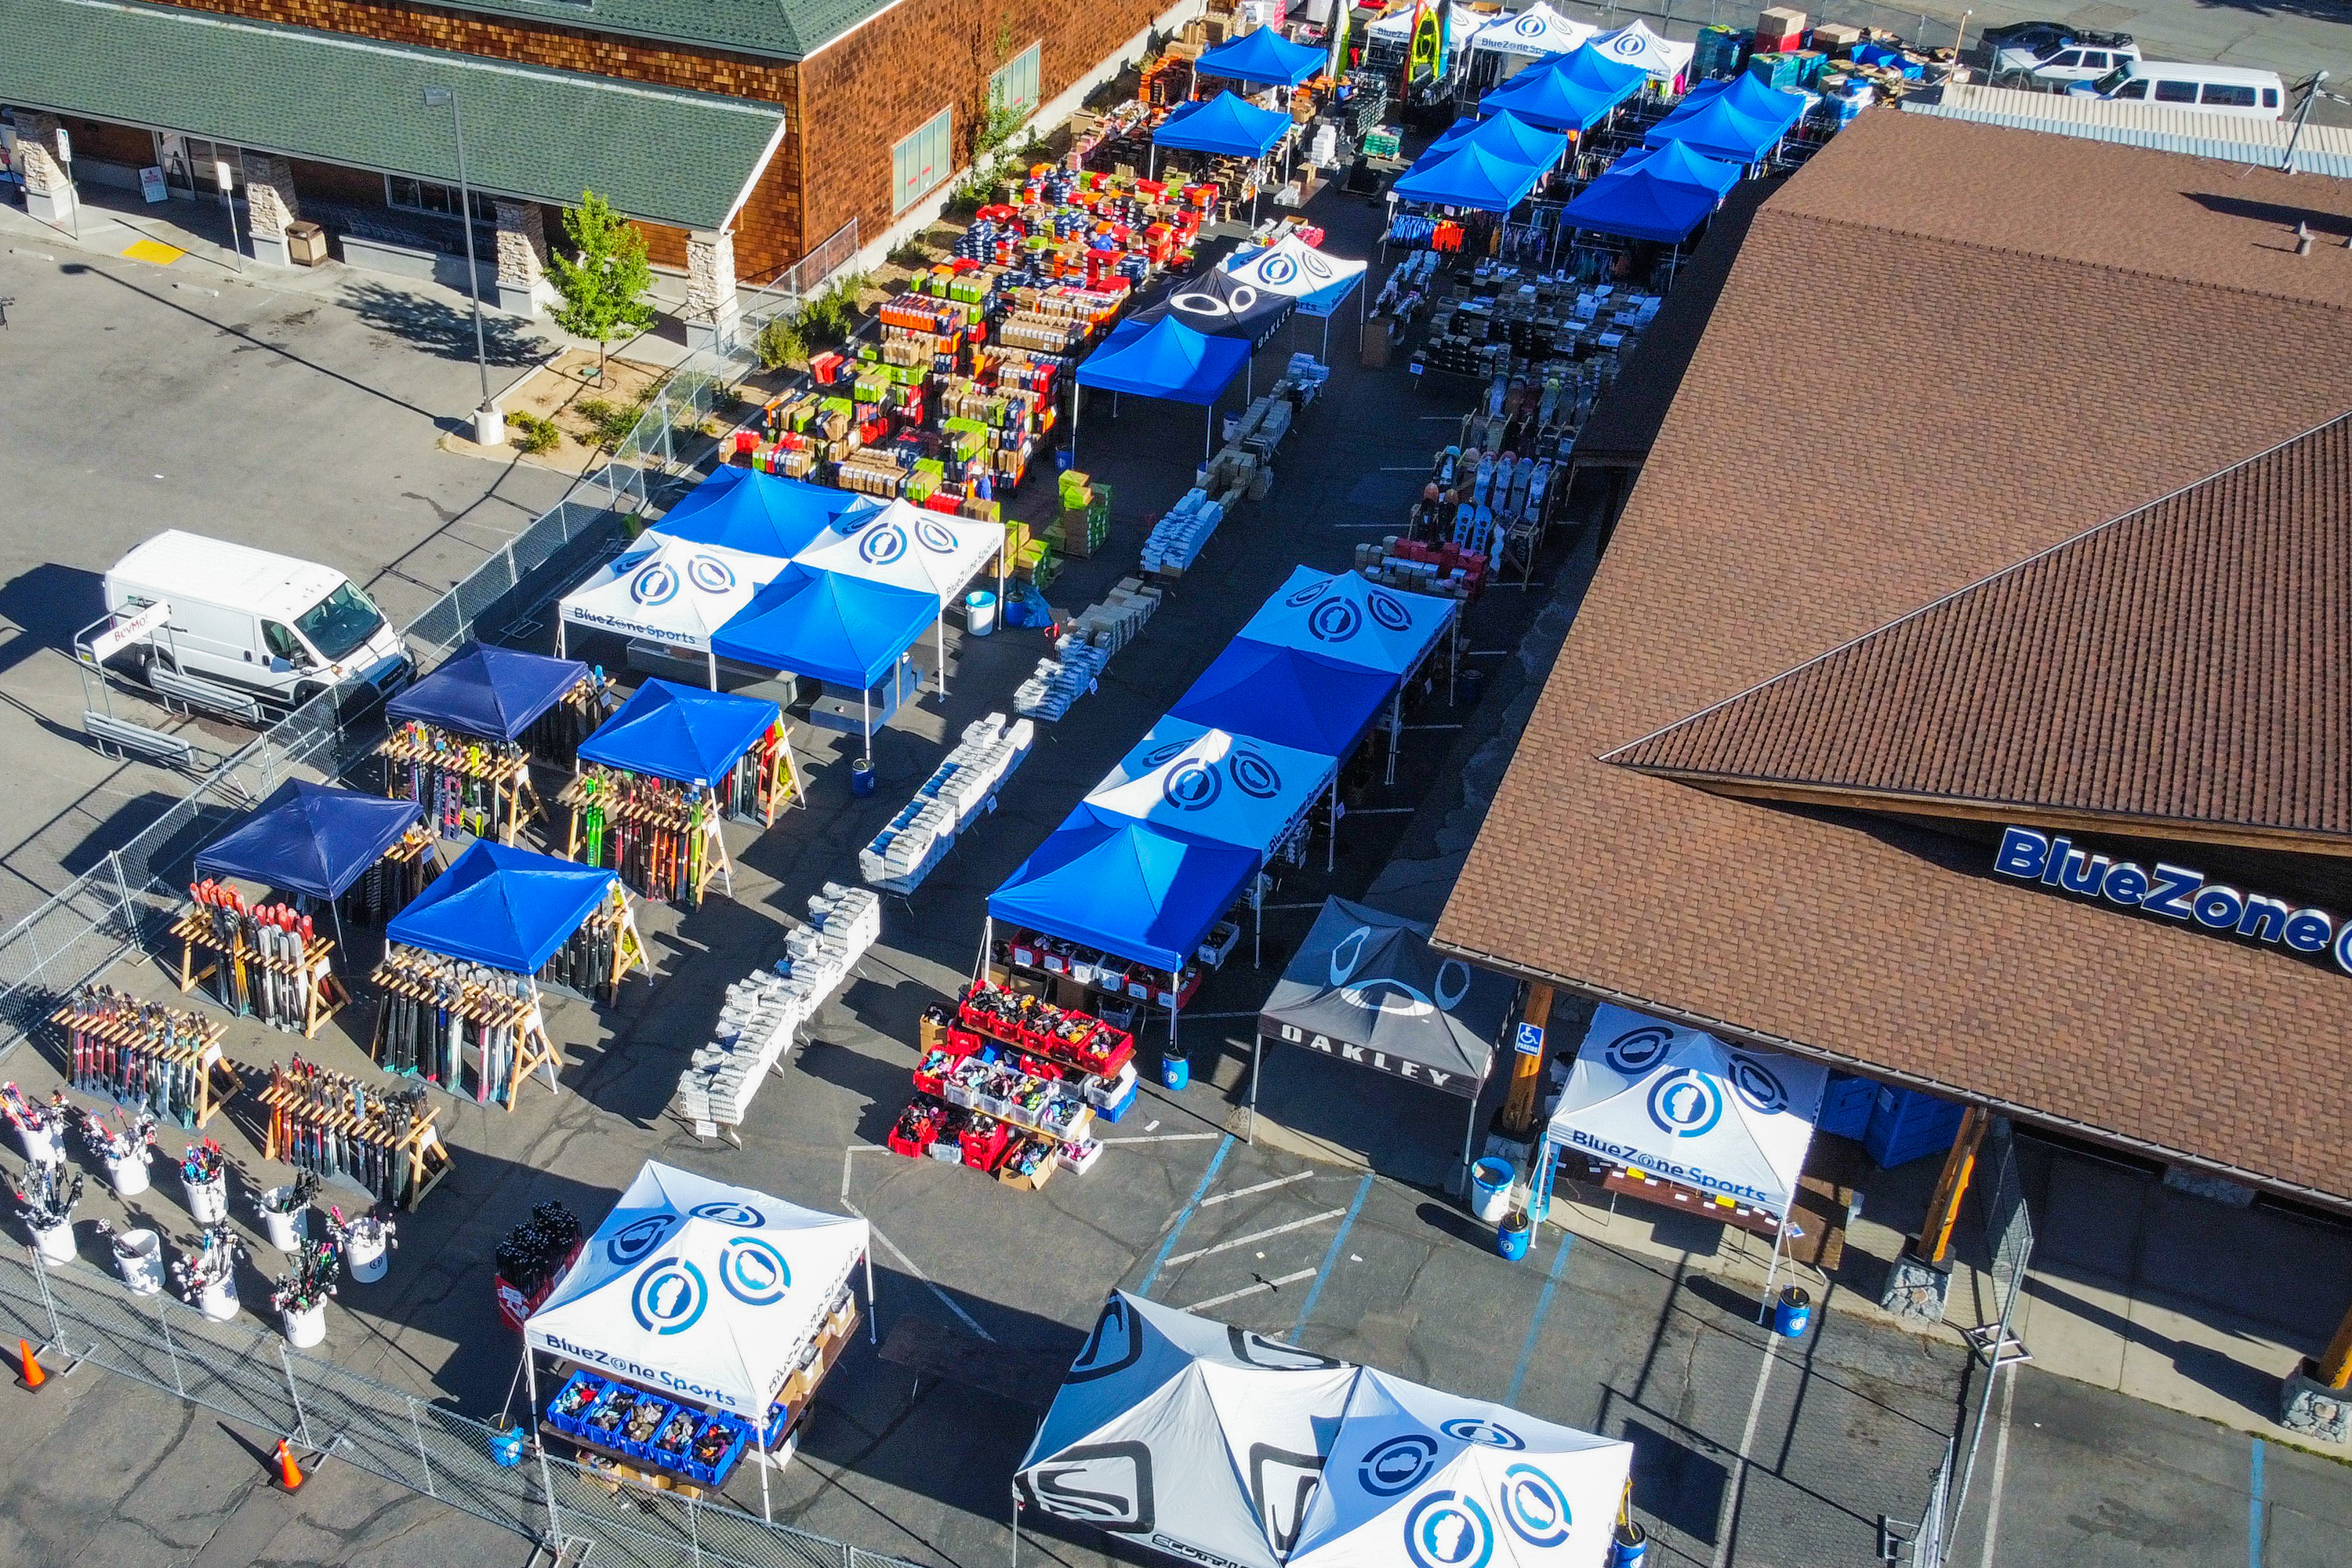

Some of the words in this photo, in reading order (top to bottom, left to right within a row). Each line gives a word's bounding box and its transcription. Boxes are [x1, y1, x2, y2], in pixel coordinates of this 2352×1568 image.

[1481, 38, 1528, 52] BlueZone
[1295, 300, 1318, 311] orts
[1258, 305, 1291, 349] OAKLEY
[574, 607, 644, 633] BlueZone
[646, 625, 696, 644] Sports
[1994, 826, 2332, 952] BlueZone
[1281, 1024, 1451, 1087] OAKLEY
[1517, 1042, 1538, 1054] PARKING
[1573, 1130, 1684, 1176] BlueZone
[1688, 1167, 1767, 1203] Sports
[546, 1334, 655, 1380] BlueZone
[659, 1370, 737, 1406] Sports
[1152, 1534, 1229, 1566] SCOTT
